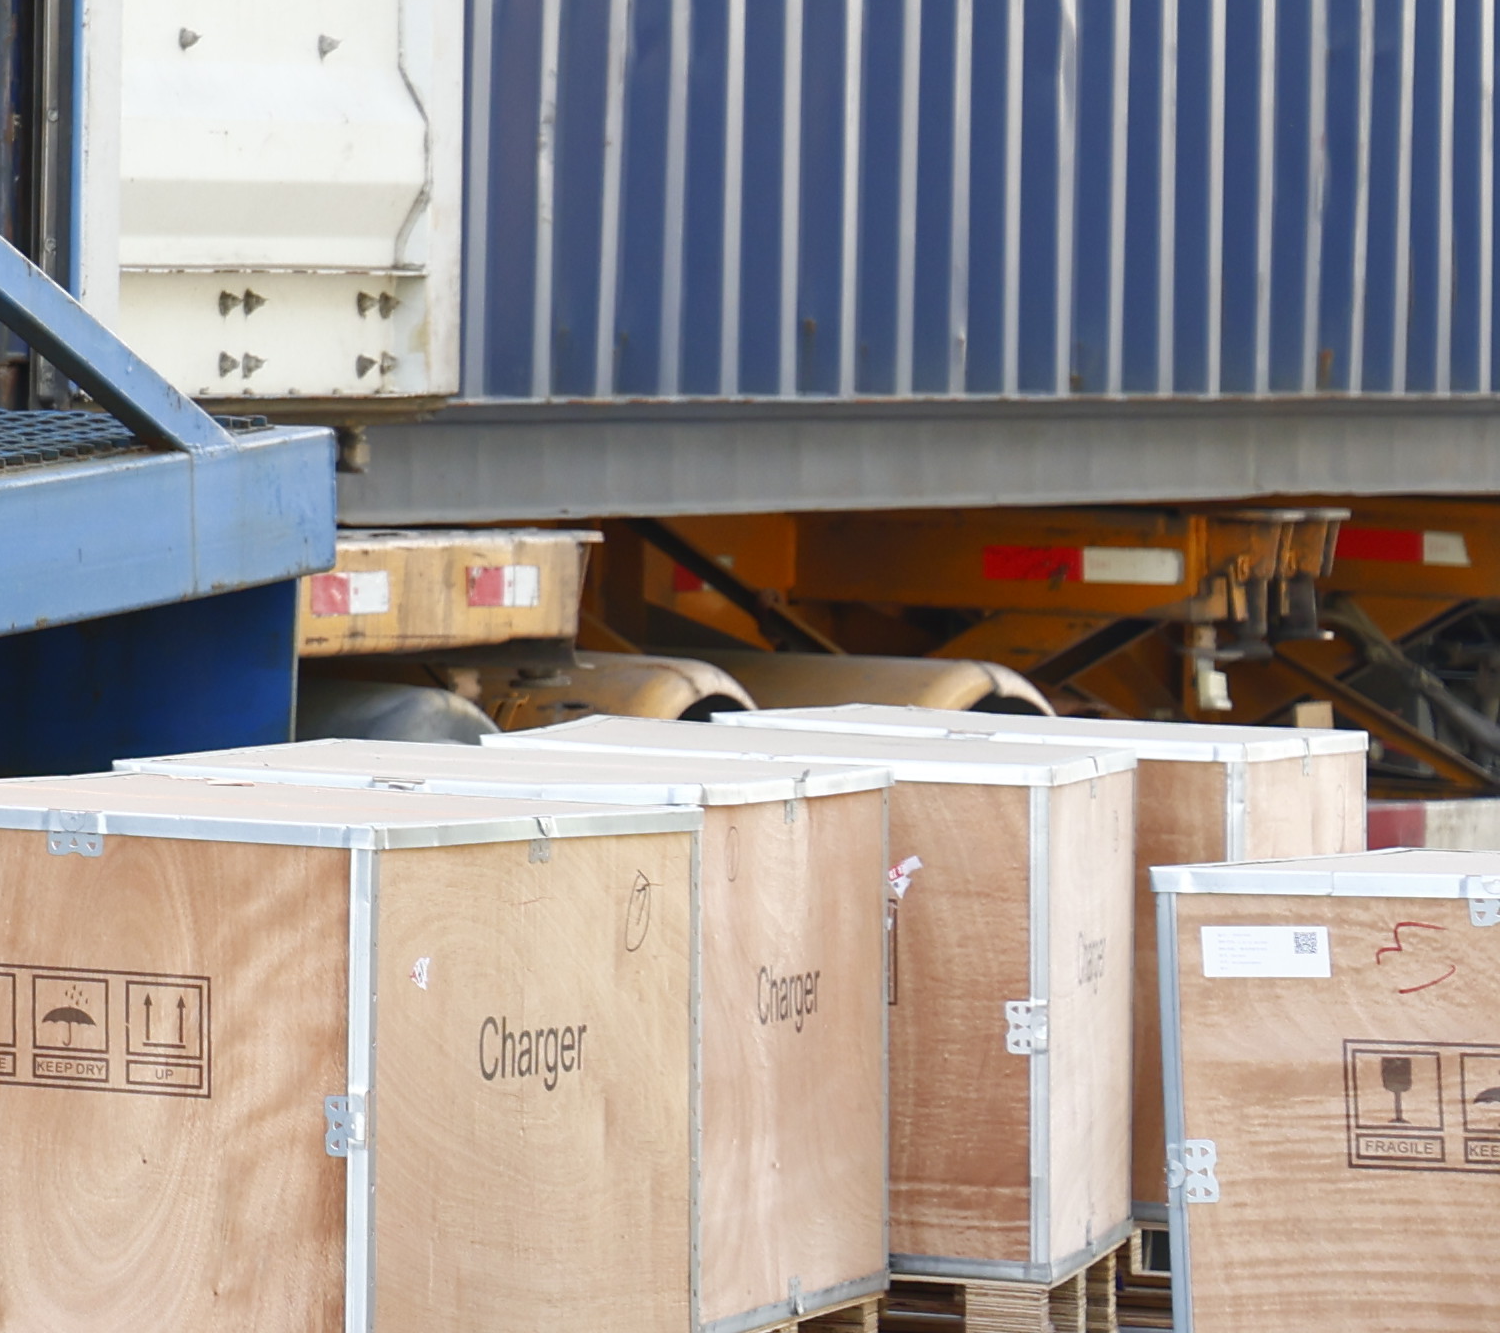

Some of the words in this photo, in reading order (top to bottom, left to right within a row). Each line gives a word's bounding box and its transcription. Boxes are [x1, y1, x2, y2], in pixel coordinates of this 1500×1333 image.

[756, 965, 822, 1034] Charger
[477, 1015, 589, 1094] Charger
[36, 1059, 73, 1076] KEEP
[76, 1063, 105, 1078] DRY
[155, 1067, 174, 1080] UP
[1365, 1139, 1435, 1156] FRAGILE
